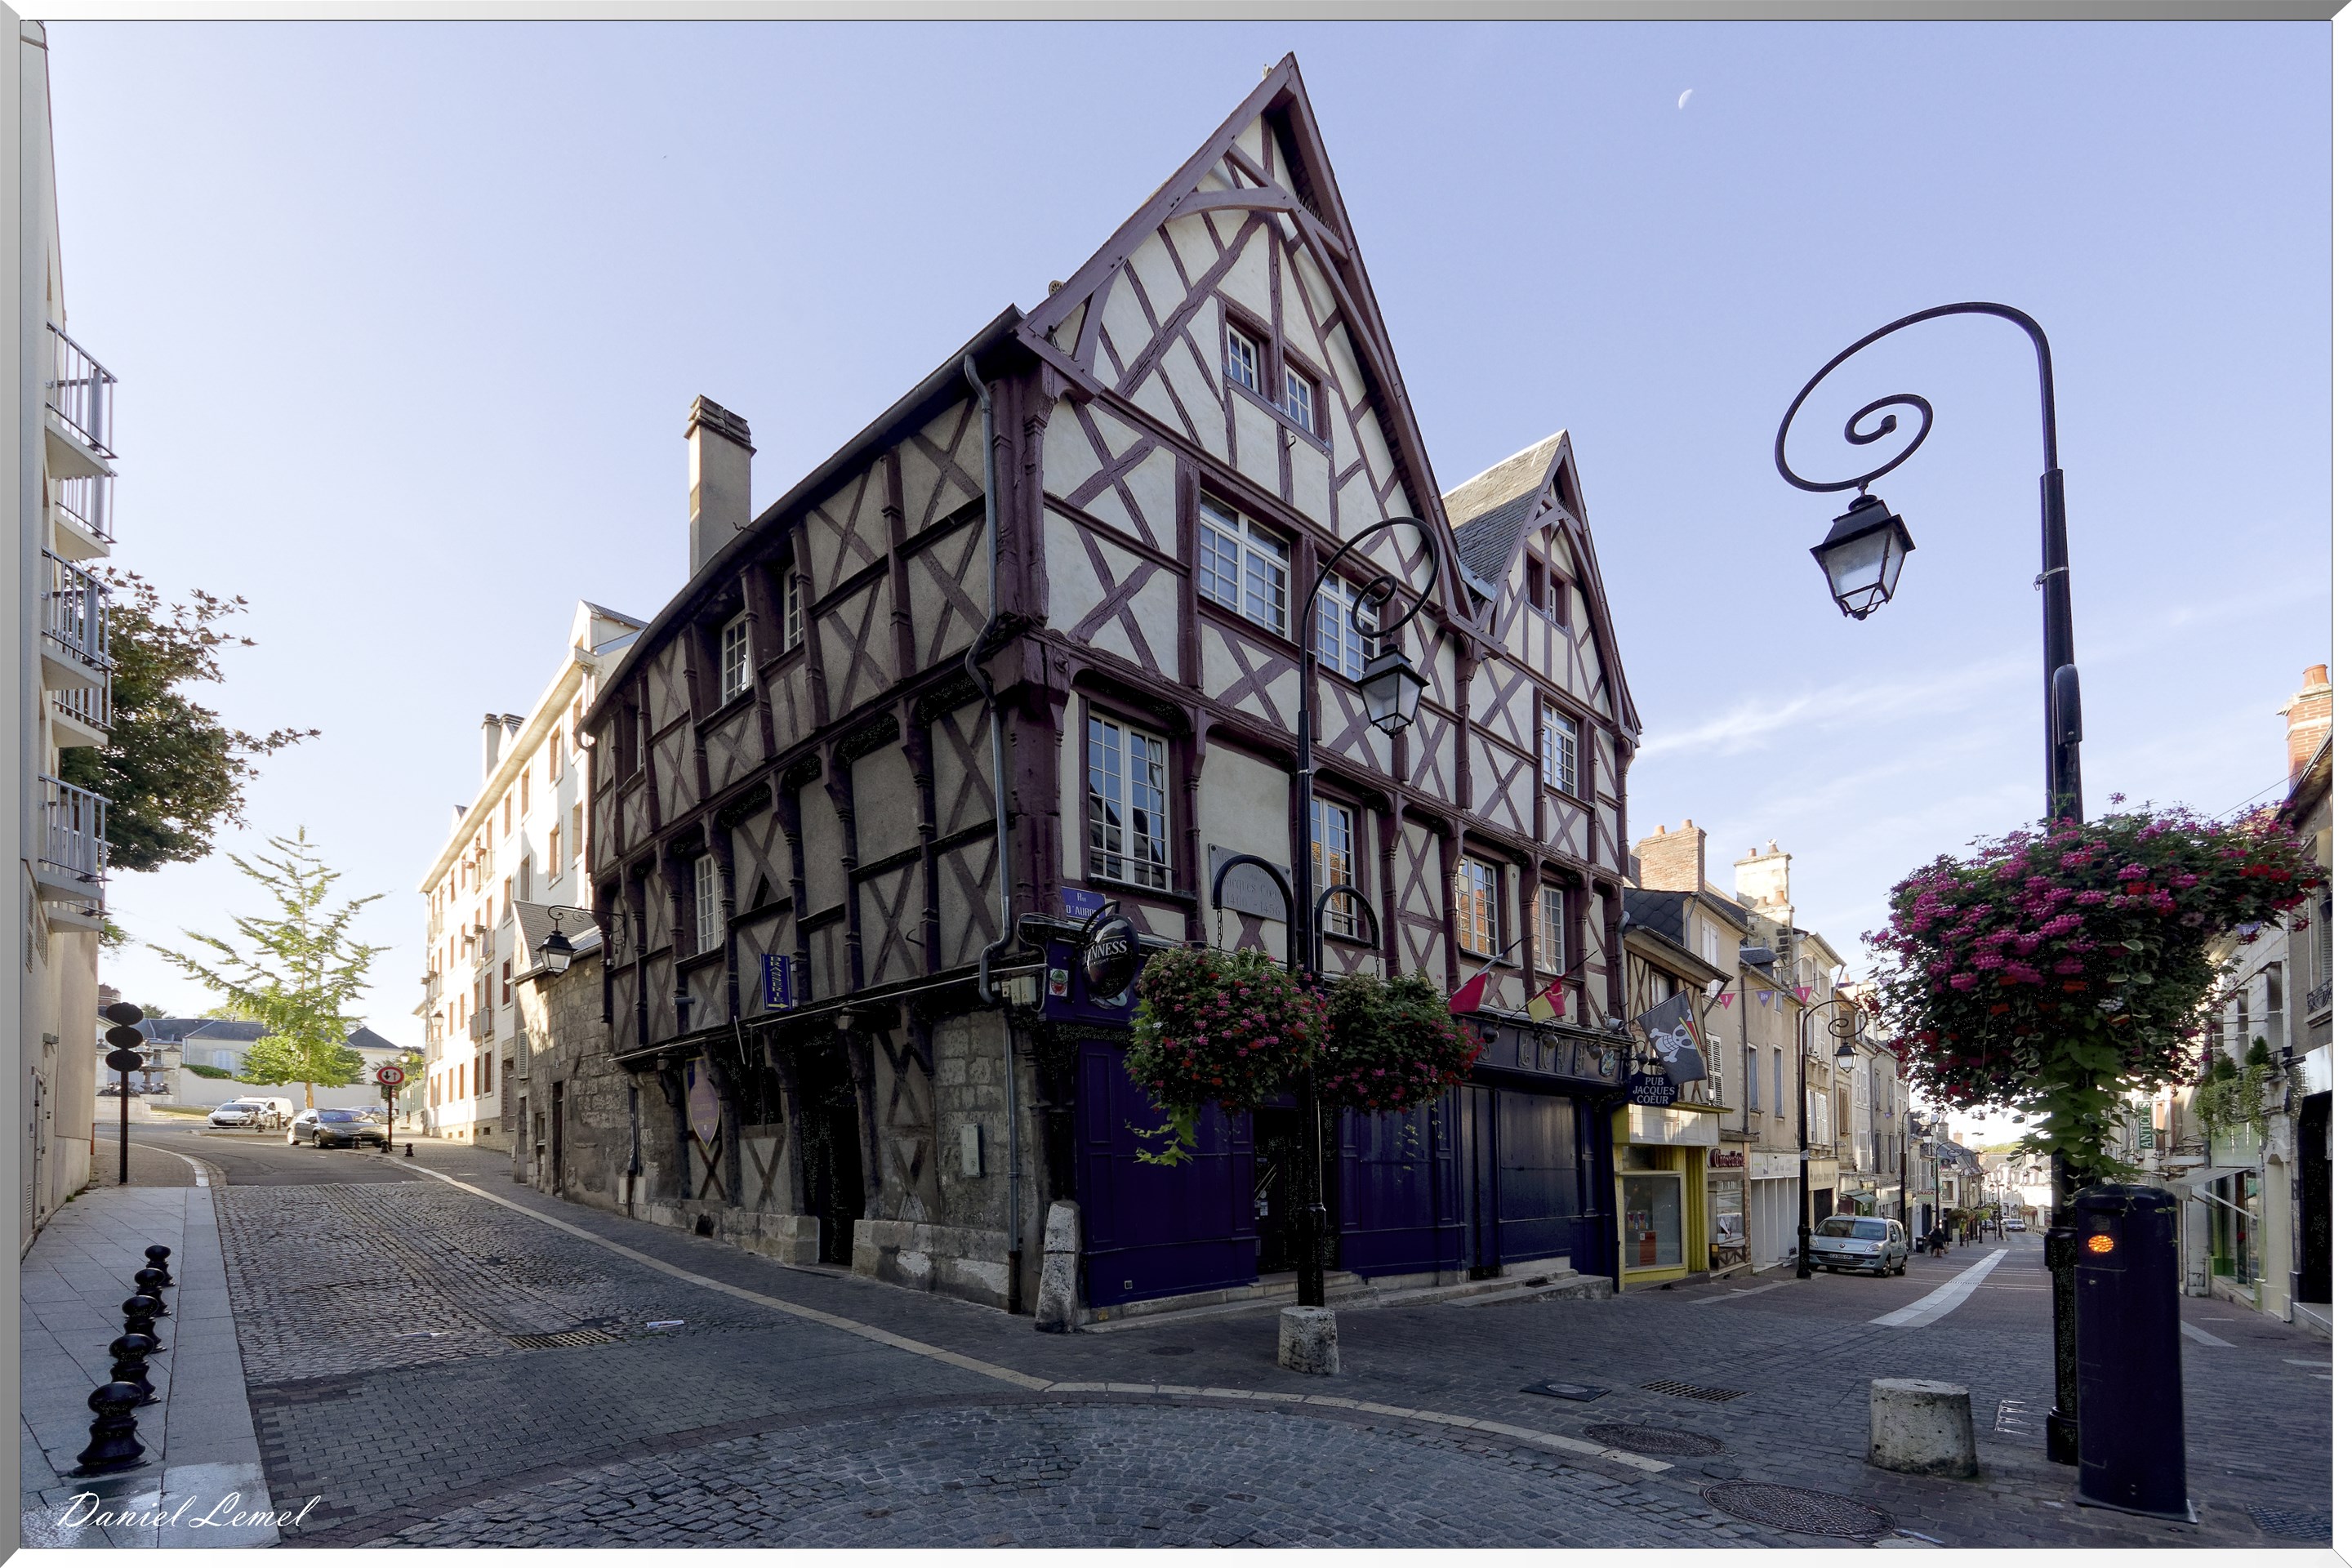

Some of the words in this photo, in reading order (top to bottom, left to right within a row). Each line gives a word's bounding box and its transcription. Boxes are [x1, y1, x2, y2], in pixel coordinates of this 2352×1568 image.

[770, 956, 784, 1002] BRASSERIE
[1645, 1076, 1664, 1086] PUB
[1633, 1085, 1675, 1096] JACQUES
[1637, 1095, 1668, 1104] COEUR
